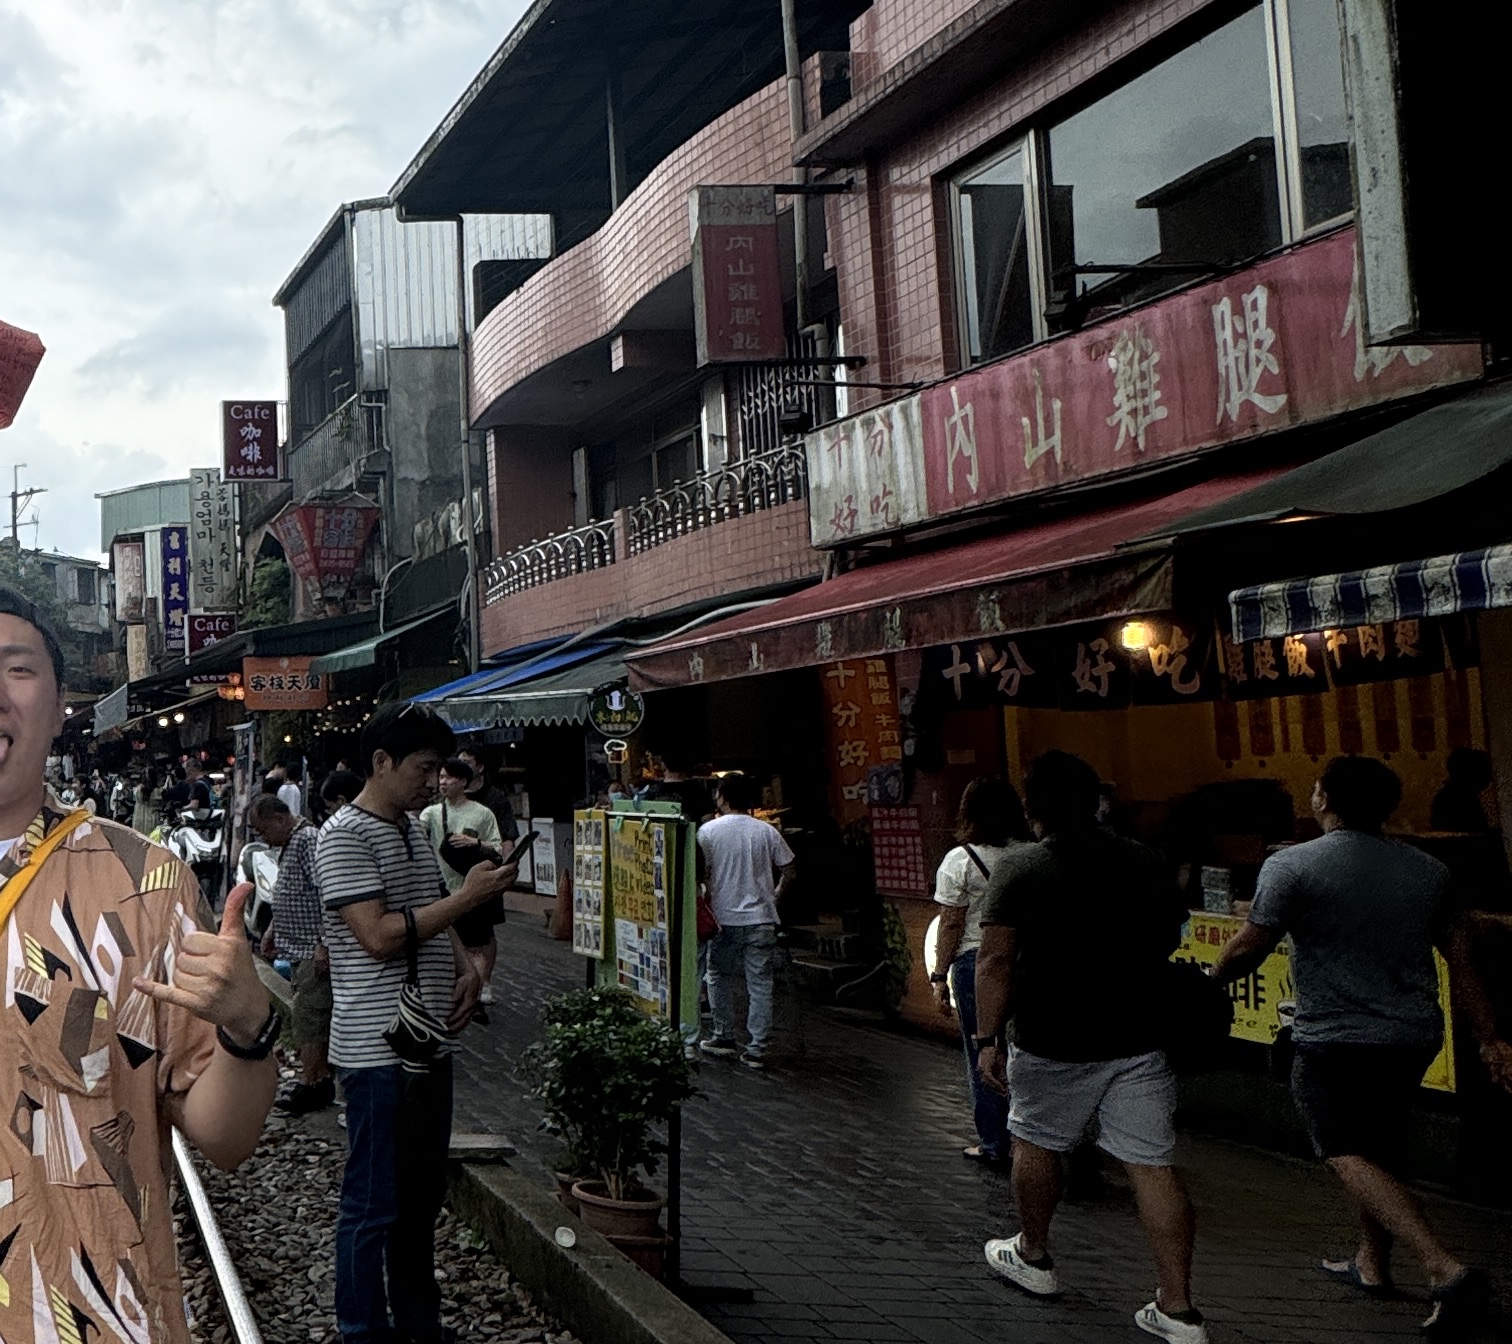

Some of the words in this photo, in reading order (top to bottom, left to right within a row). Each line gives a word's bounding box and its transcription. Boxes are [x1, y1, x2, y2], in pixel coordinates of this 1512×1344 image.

[942, 241, 1433, 494] 內山雞腿
[230, 404, 270, 420] Cafe
[239, 422, 262, 463] 咖啡
[827, 411, 894, 469] 十分
[829, 482, 901, 537] 好吃
[197, 557, 218, 593] 천등
[194, 618, 229, 632] Cafe
[941, 625, 1201, 702] 十分好吃
[823, 661, 869, 806] 十分好吃
